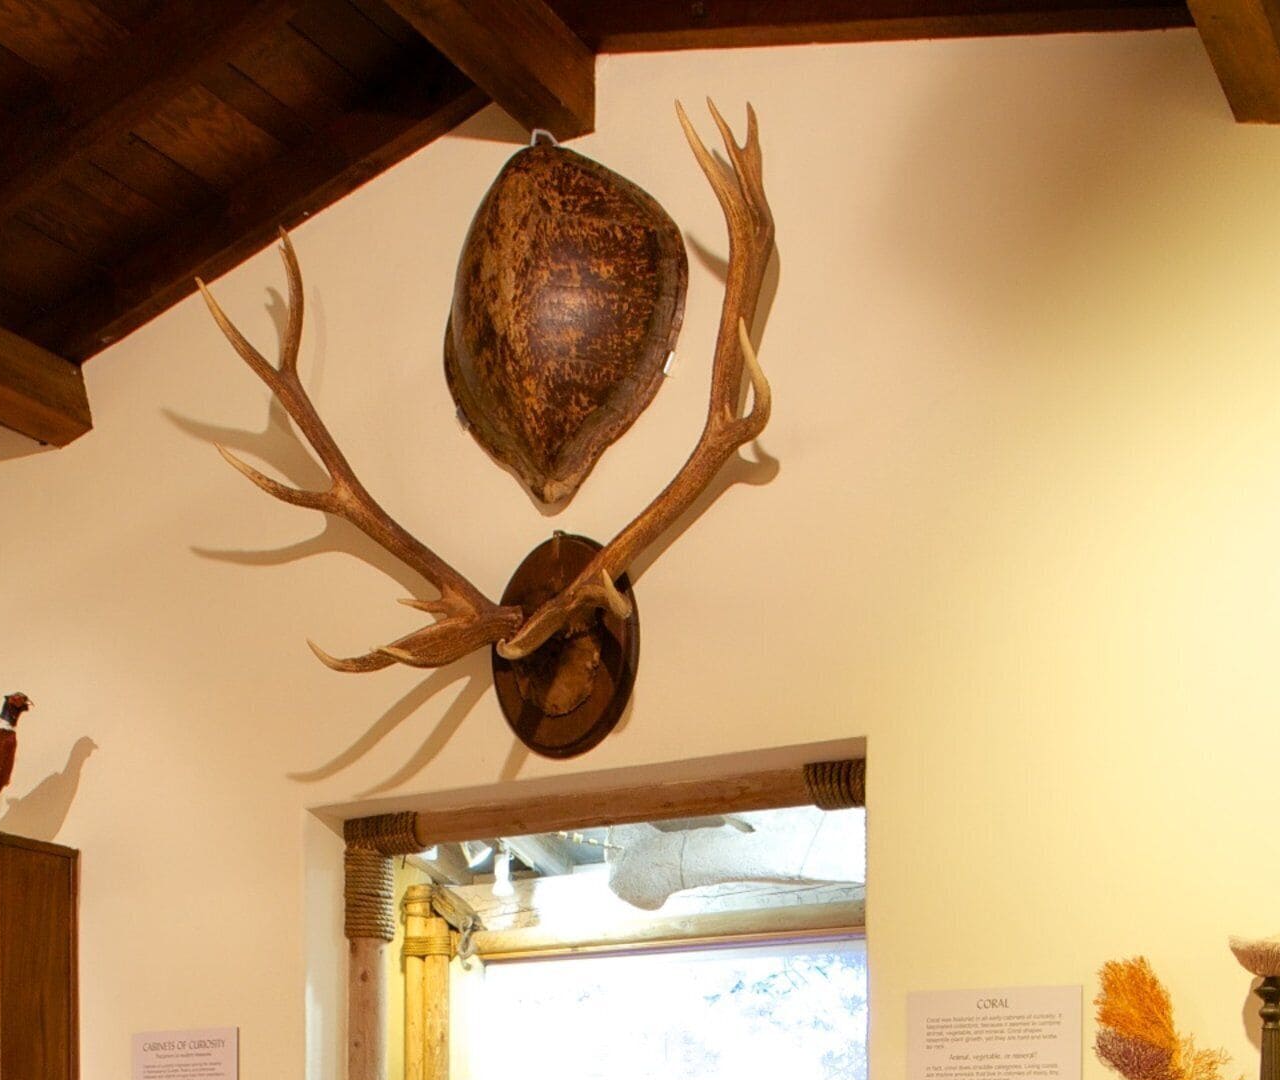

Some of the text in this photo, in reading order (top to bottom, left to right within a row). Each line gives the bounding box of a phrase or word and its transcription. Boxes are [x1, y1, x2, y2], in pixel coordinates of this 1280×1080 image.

[976, 999, 1010, 1009] CORAL
[142, 1039, 225, 1051] CABINETS OF CURIOSITY
